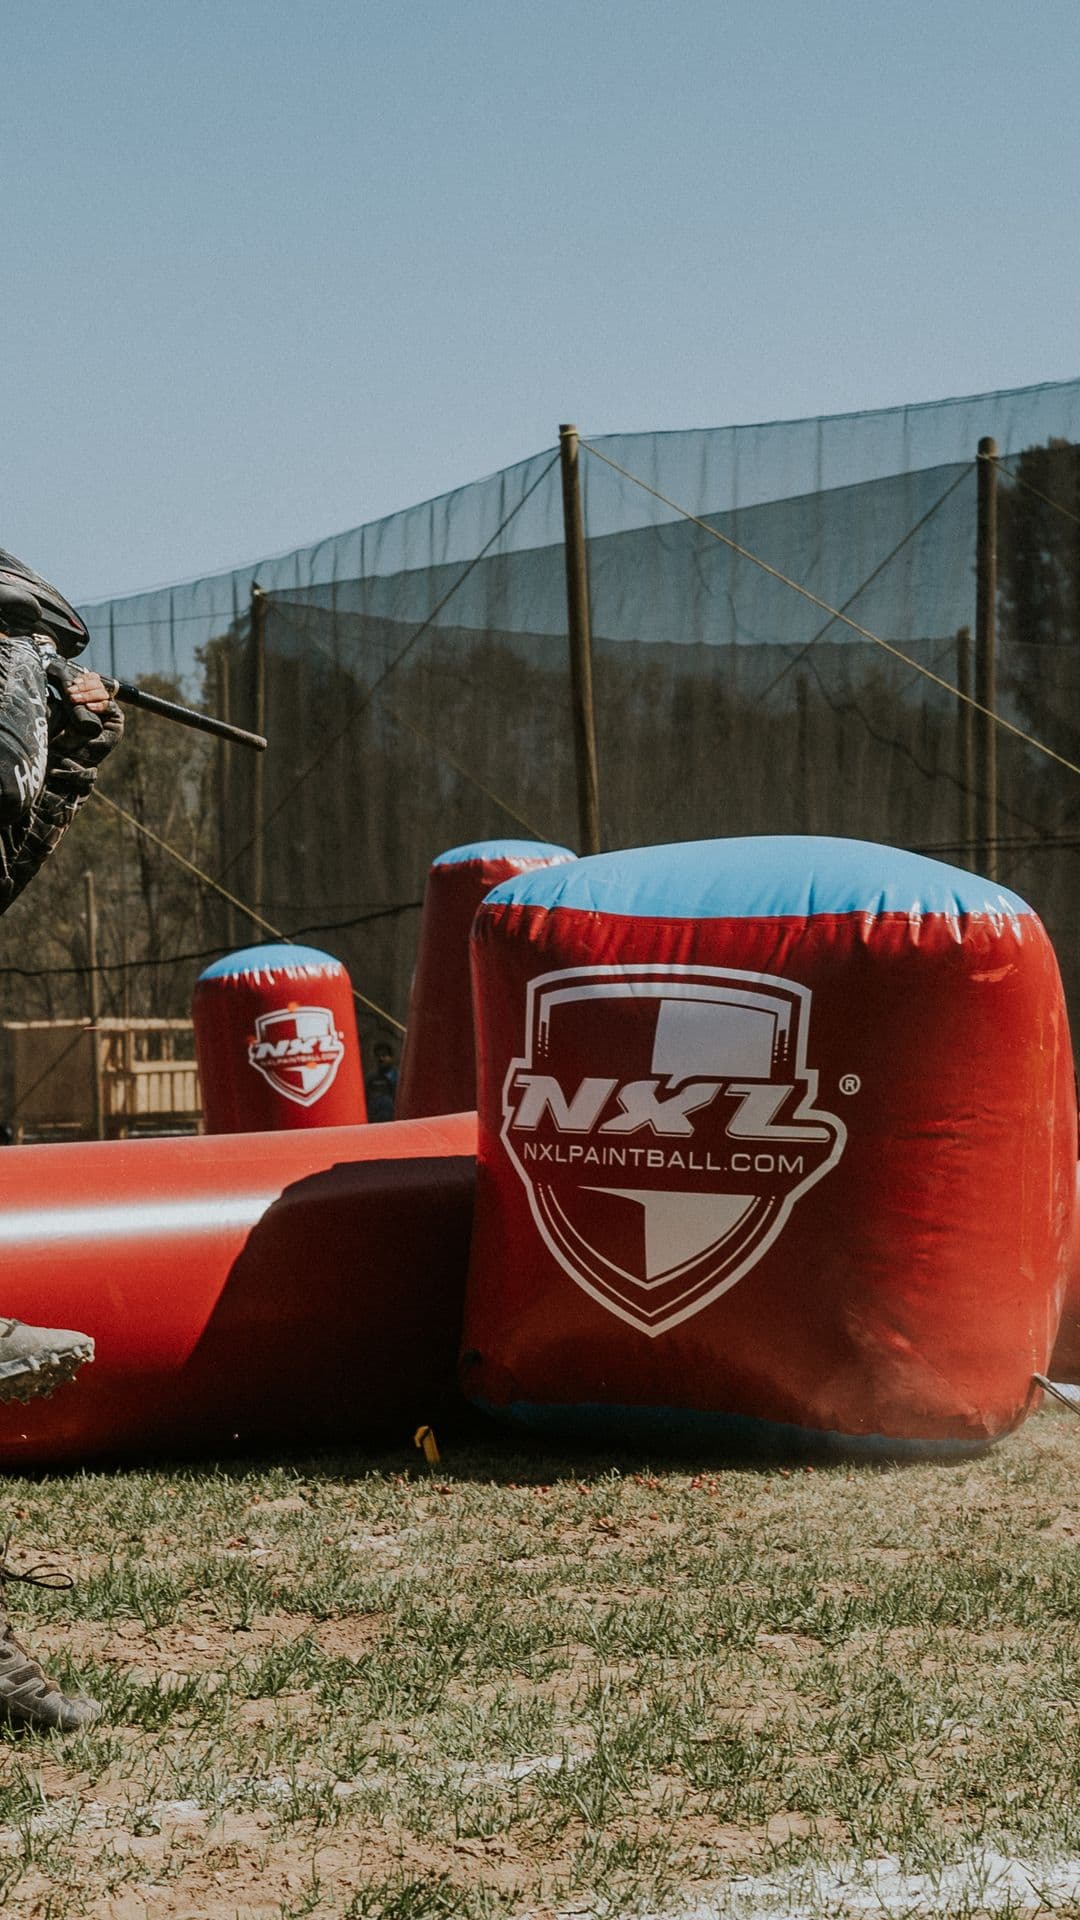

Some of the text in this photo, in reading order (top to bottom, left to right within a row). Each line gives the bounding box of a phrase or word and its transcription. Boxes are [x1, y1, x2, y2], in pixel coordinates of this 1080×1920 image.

[255, 1036, 340, 1058] NXL
[512, 1074, 830, 1143] NXL
[523, 1142, 804, 1174] NXLPAINTBALL.COM
